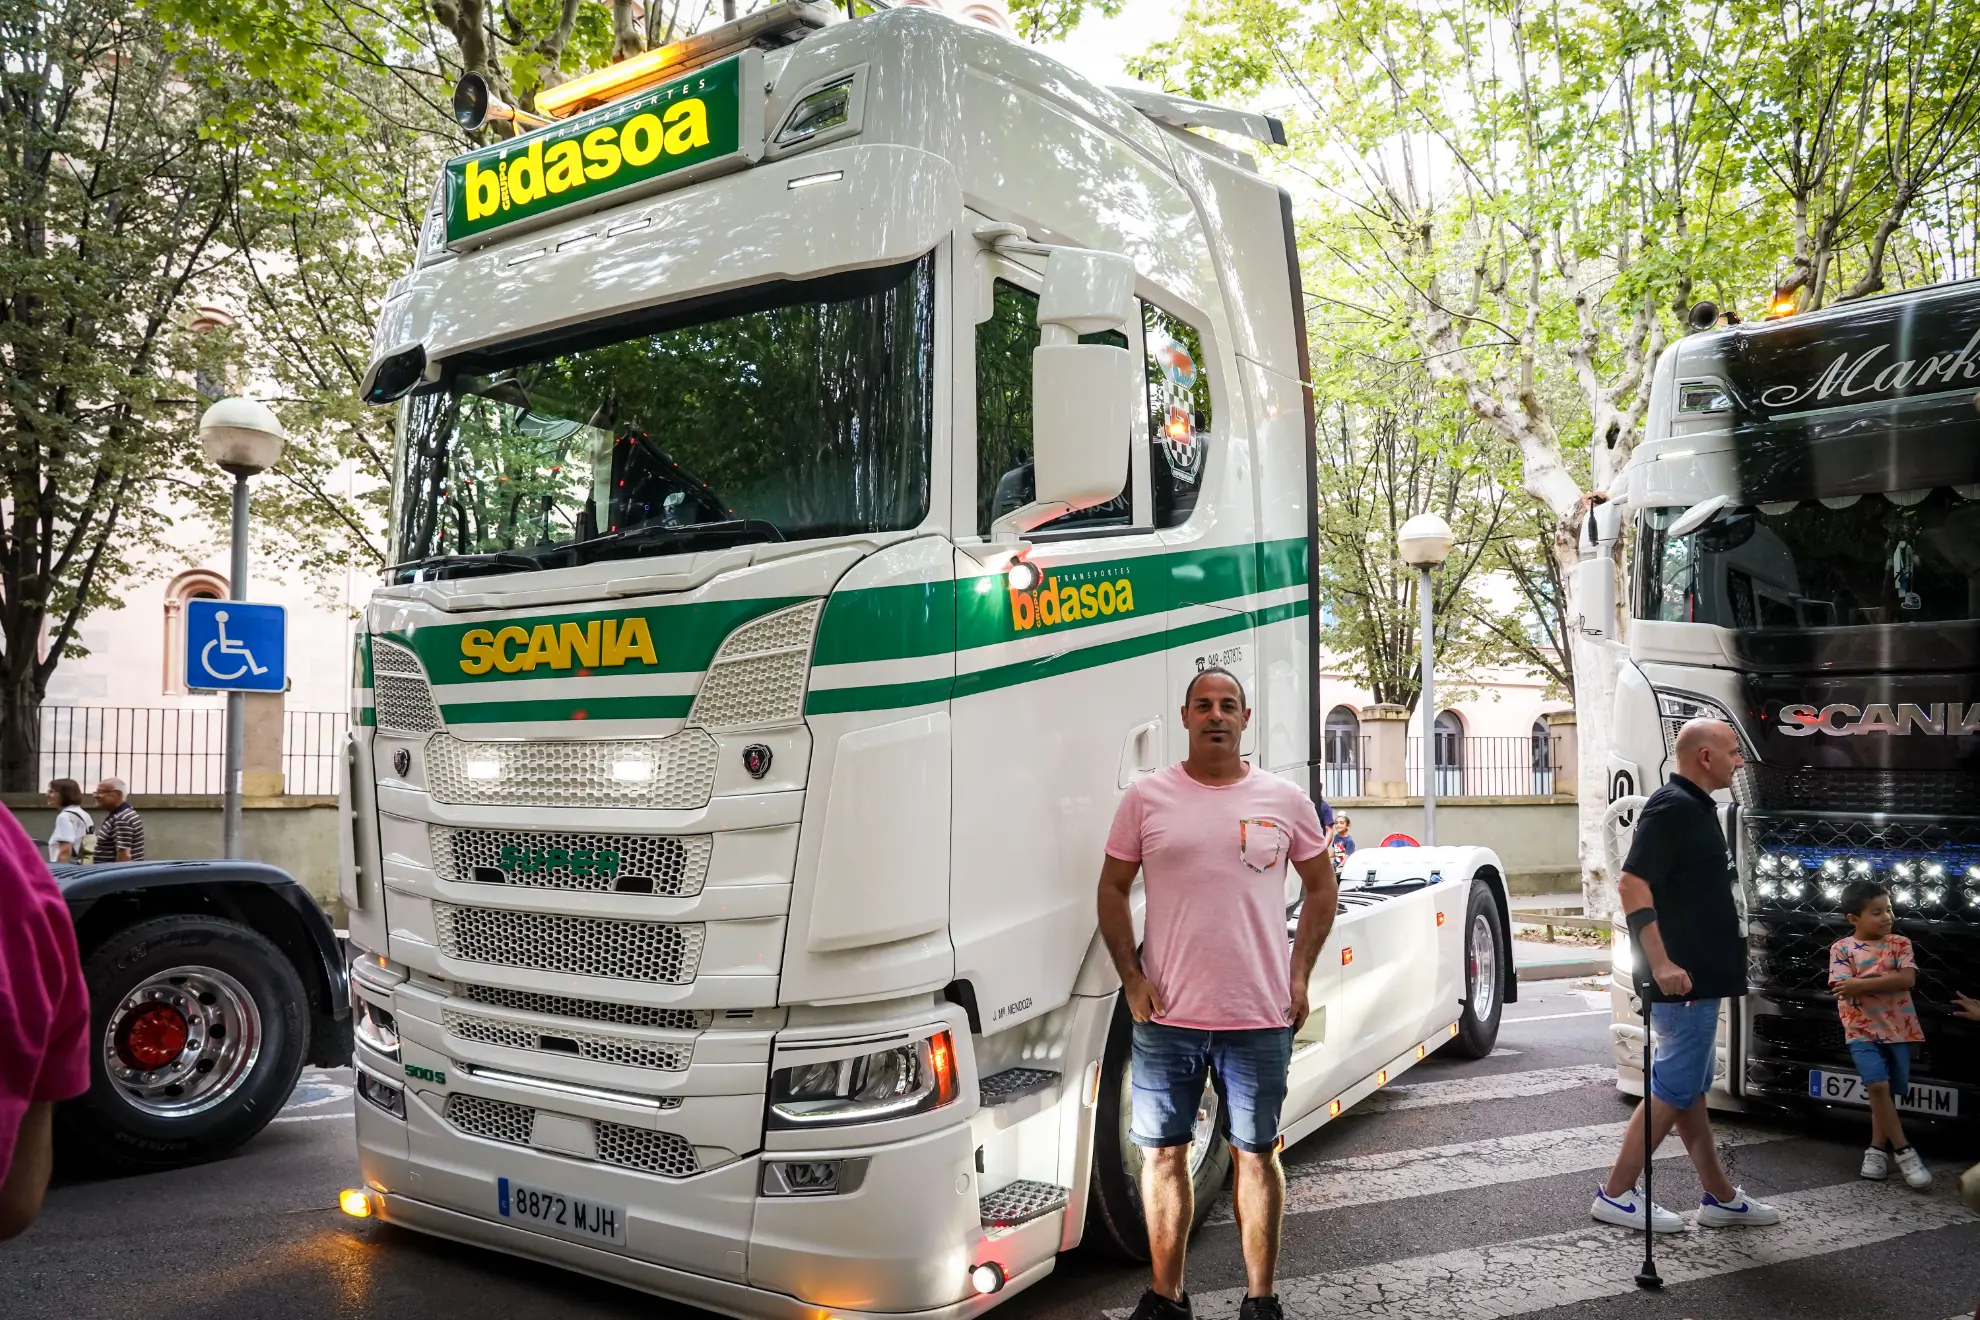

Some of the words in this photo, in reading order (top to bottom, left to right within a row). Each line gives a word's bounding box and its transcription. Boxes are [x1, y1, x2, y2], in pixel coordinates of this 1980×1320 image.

[545, 79, 705, 142] TRANSPORTES
[499, 162, 511, 211] GRUPO
[1057, 567, 1130, 582] TRANSPORTES
[460, 617, 658, 675] SCANIA
[499, 846, 619, 876] SUPER
[1008, 997, 1033, 1015] MENDOZA
[1826, 1076, 1870, 1101] 67
[516, 1188, 567, 1226] 8872
[574, 1201, 615, 1238] MJH
